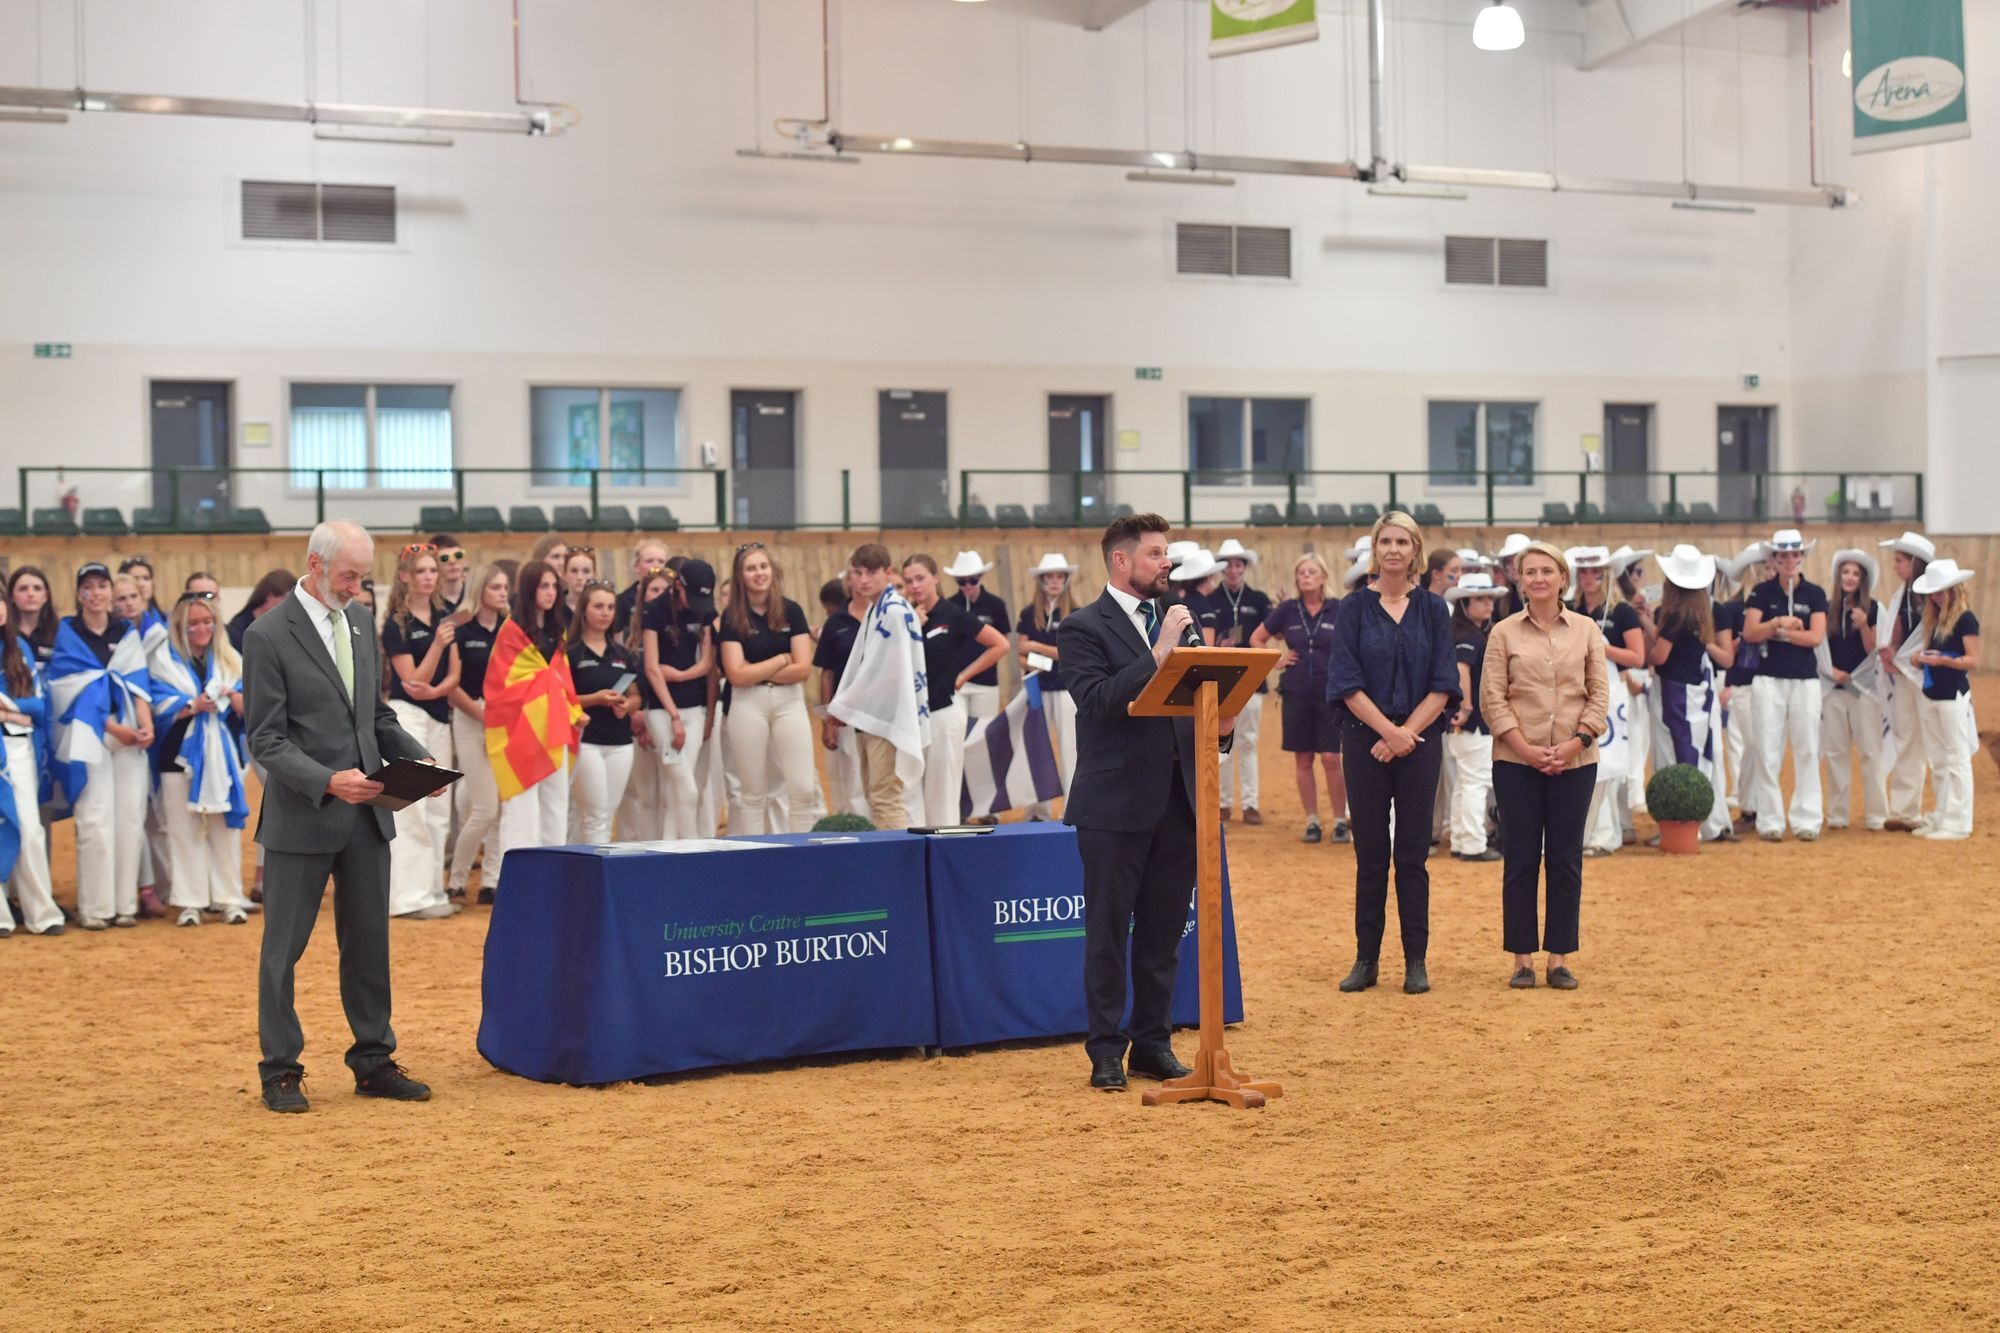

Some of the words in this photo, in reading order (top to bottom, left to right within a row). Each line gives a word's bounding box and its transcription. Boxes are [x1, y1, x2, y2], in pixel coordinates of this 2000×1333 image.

[1870, 67, 1930, 108] Arena
[663, 918, 745, 941] University
[749, 914, 801, 933] Centre
[993, 895, 1086, 925] BISHOP
[664, 942, 767, 977] BISHOP
[775, 930, 888, 966] BURTON
